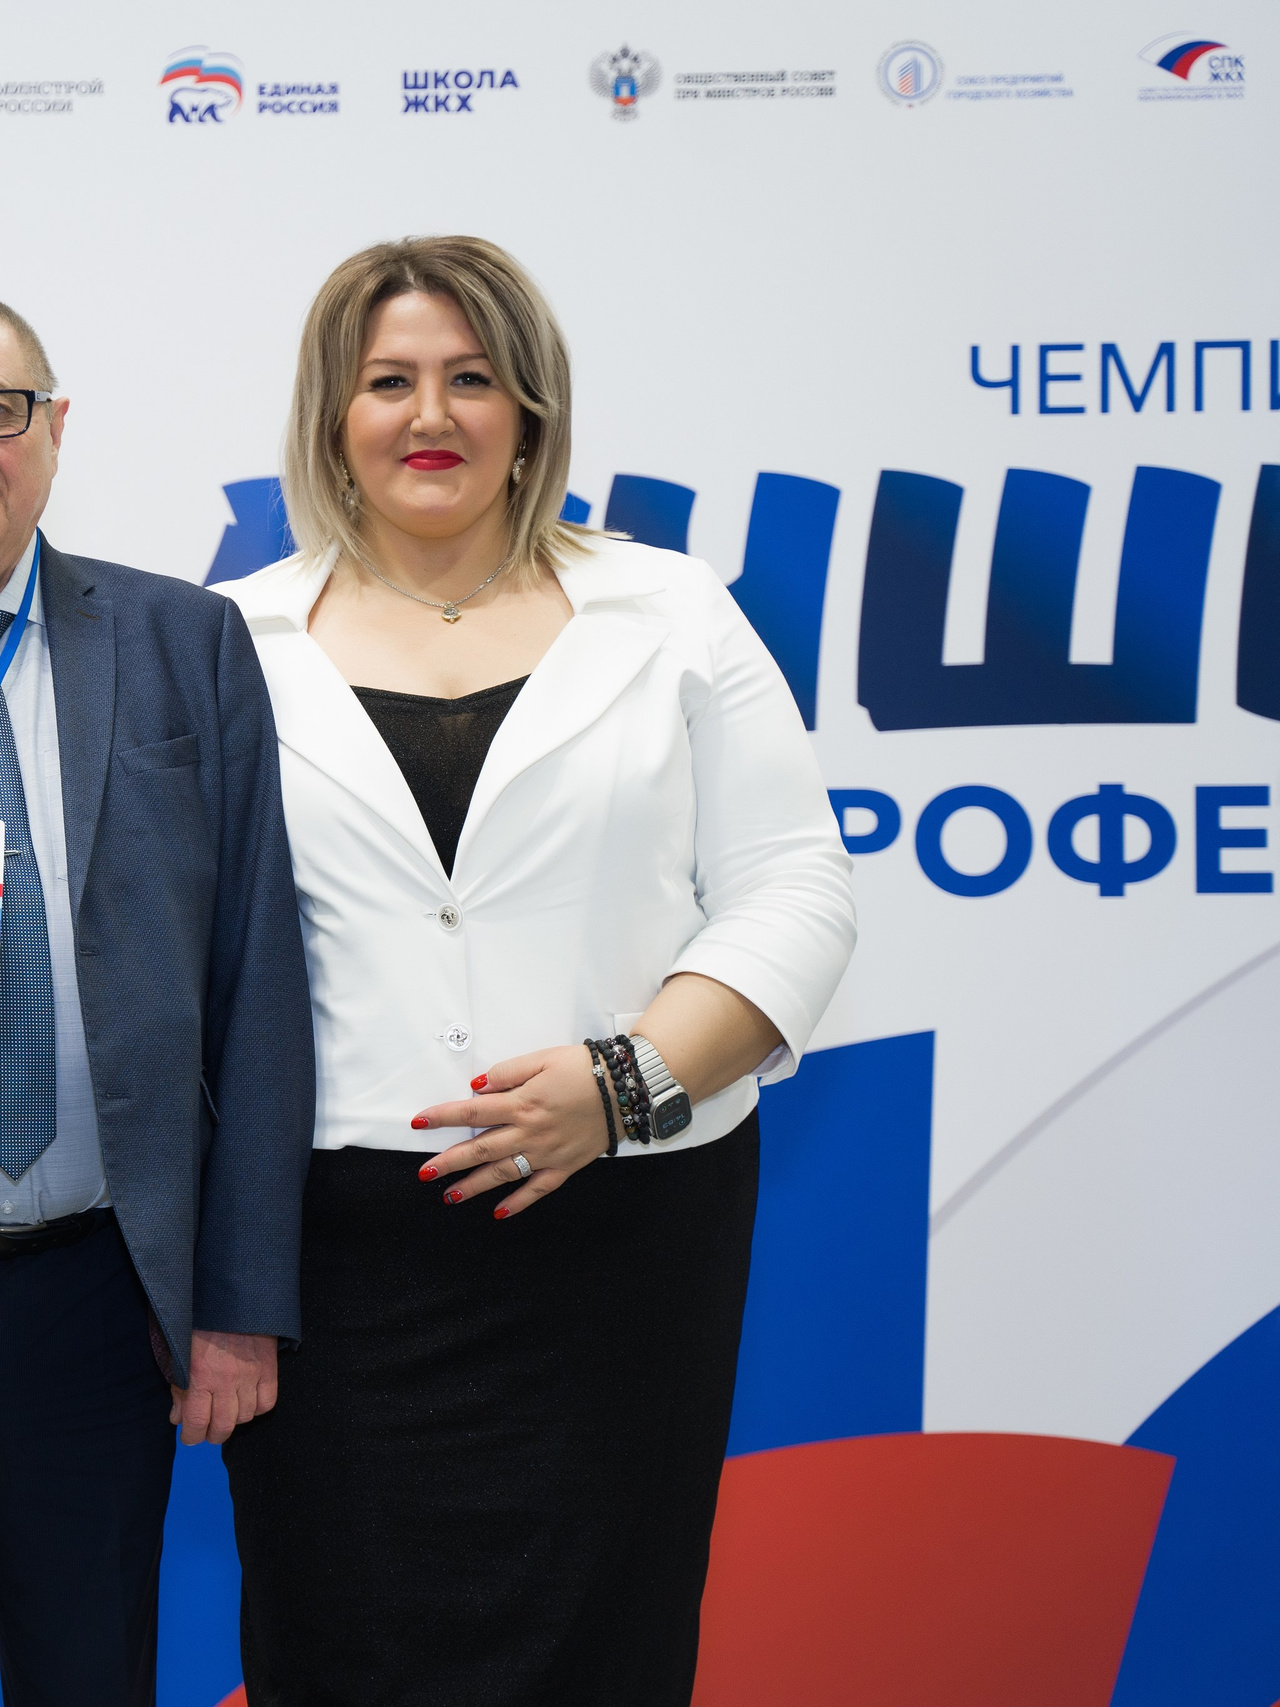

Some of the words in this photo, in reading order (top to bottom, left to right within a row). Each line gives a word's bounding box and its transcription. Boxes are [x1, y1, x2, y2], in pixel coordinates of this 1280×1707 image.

[1208, 55, 1245, 70] СПК
[403, 70, 519, 90] ШКОЛА
[258, 84, 339, 97] ЕДИНАЯ
[258, 101, 339, 114] РОССИЯ
[403, 93, 474, 113] ЖКХ
[970, 338, 1280, 415] ЧЕМП
